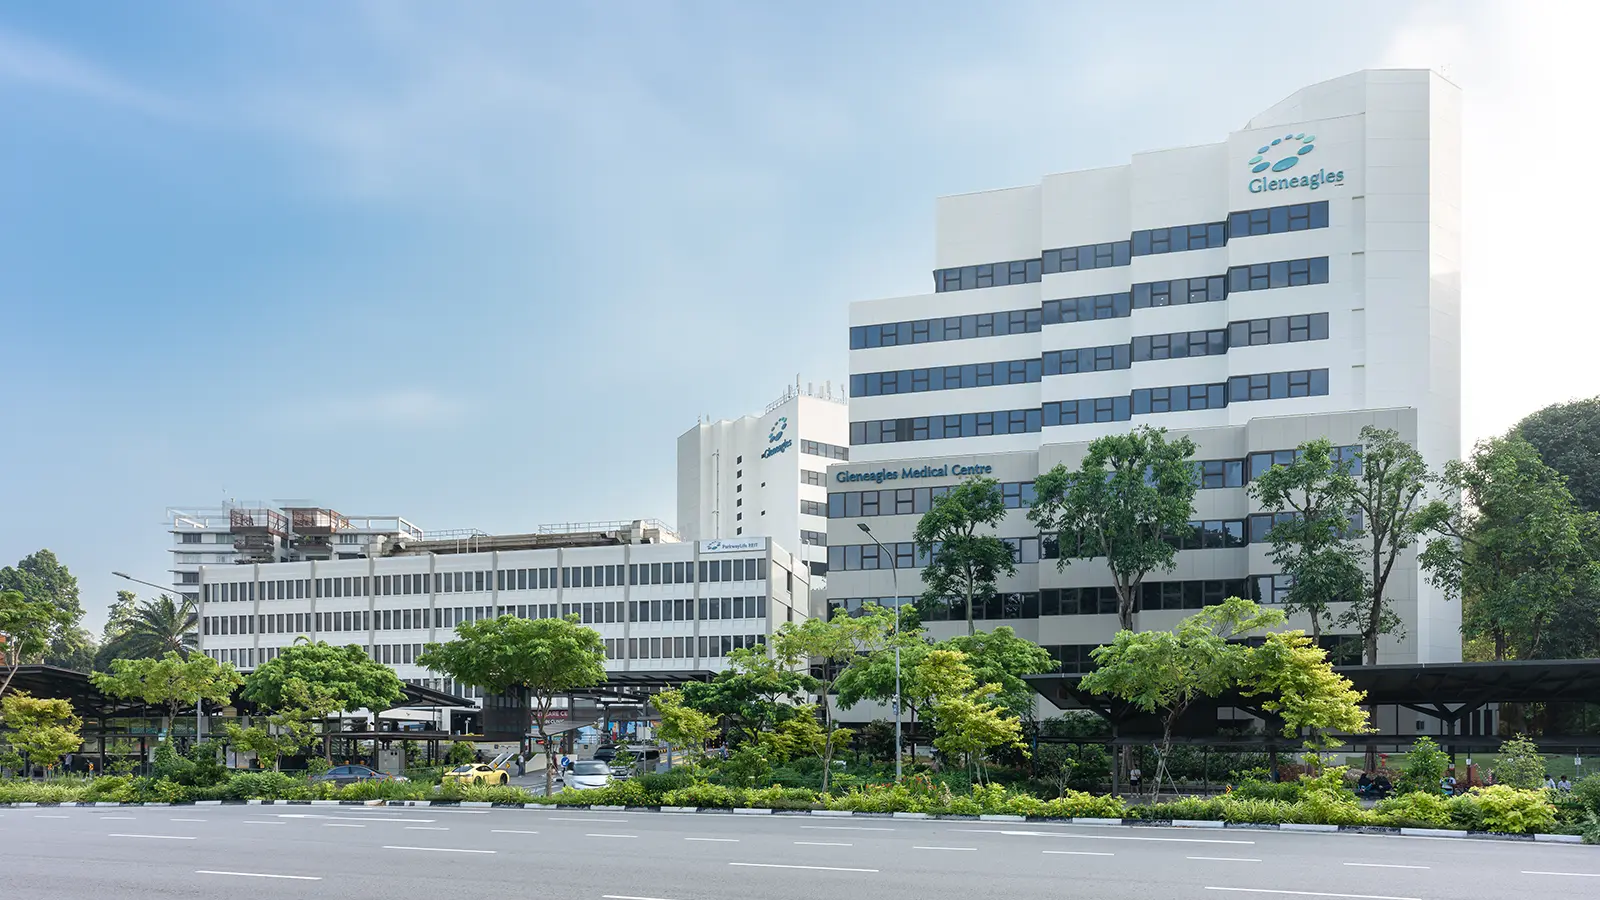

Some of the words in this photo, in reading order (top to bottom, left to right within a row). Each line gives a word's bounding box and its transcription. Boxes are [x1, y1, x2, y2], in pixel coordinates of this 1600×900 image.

[1248, 168, 1345, 193] Gleneagles
[763, 439, 792, 459] Gleneagles
[836, 468, 898, 483] Gleneagles
[901, 464, 948, 479] Medical
[951, 464, 992, 476] Centre
